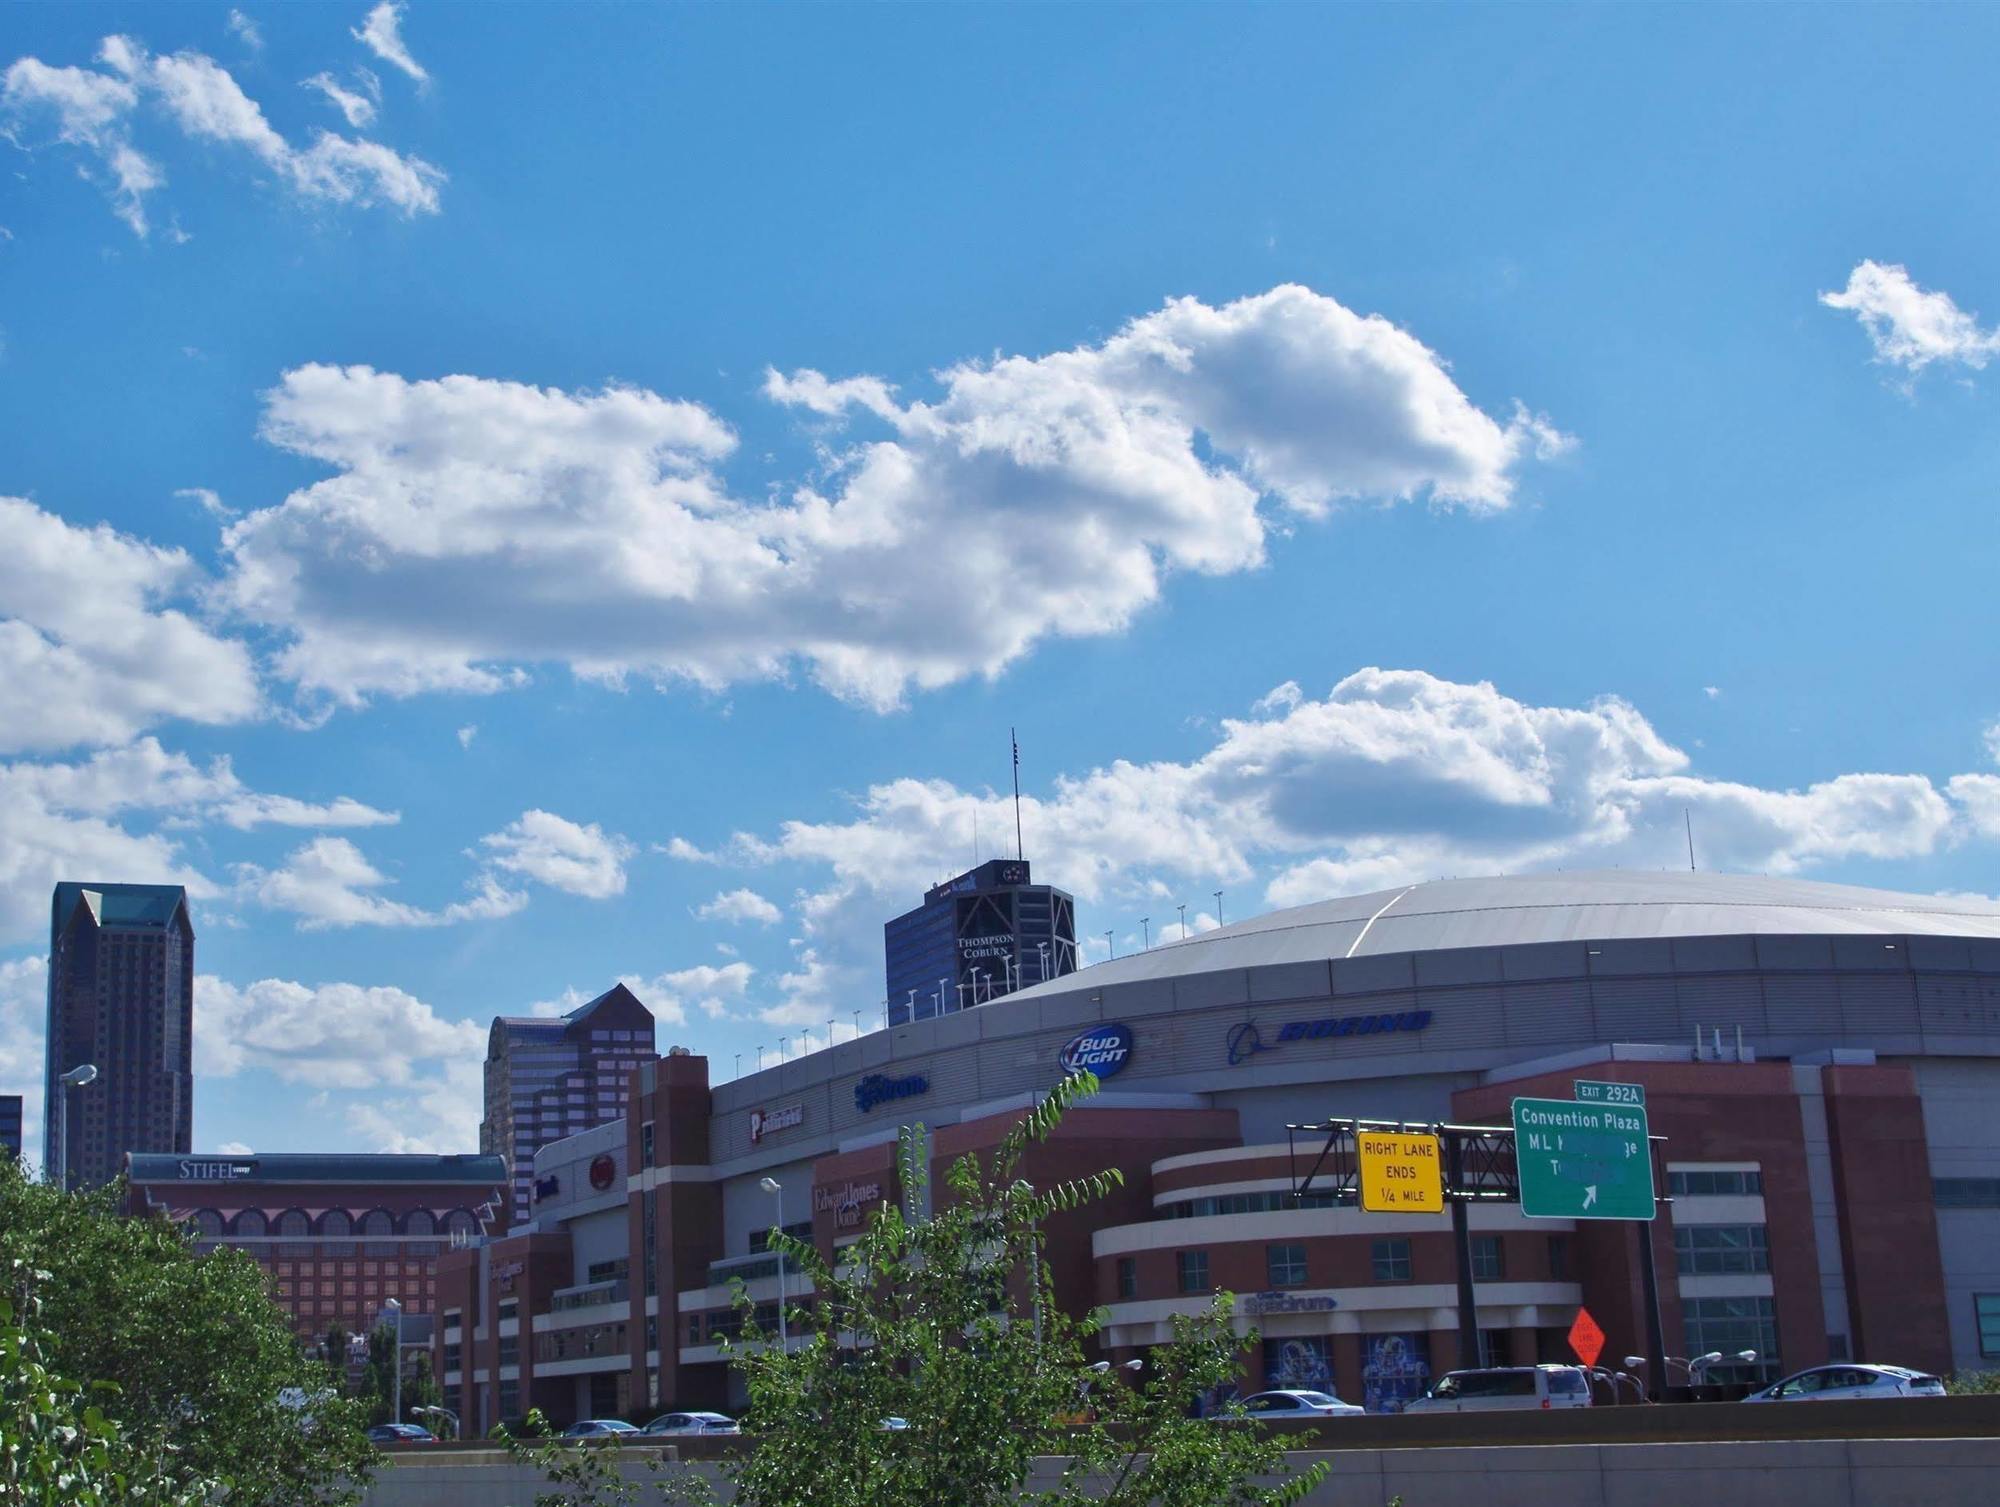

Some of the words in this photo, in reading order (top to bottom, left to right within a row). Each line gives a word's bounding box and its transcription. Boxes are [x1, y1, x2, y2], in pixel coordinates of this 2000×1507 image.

[958, 934, 1014, 948] THOMPSON
[963, 946, 1008, 959] COBURN
[1078, 1036, 1121, 1053] BUD
[1069, 1048, 1127, 1066] LIGHT
[1581, 1086, 1600, 1098] EXIT
[1606, 1086, 1639, 1102] 292A
[1521, 1107, 1599, 1128] Convention
[1604, 1113, 1640, 1131] Plaza
[1365, 1142, 1398, 1155] RIGHT
[1404, 1144, 1433, 1157] LANE
[179, 1160, 238, 1179] STIFEL
[1386, 1166, 1416, 1179] ENDS
[1403, 1190, 1425, 1202] MILE
